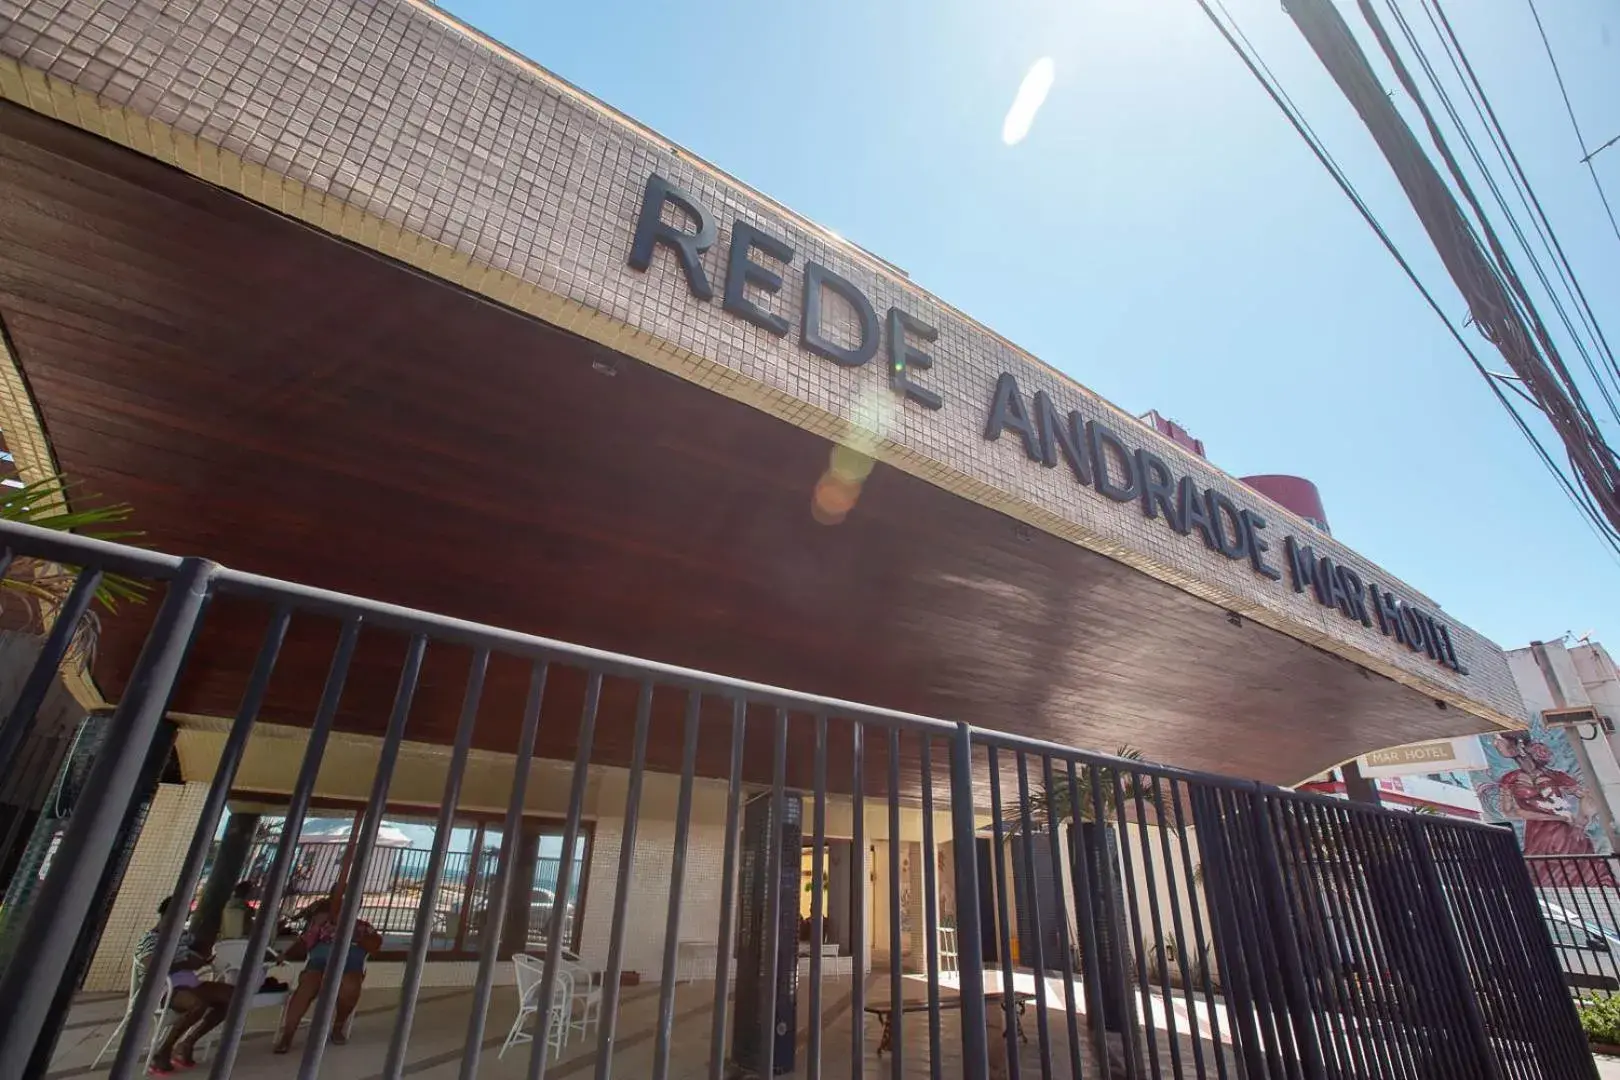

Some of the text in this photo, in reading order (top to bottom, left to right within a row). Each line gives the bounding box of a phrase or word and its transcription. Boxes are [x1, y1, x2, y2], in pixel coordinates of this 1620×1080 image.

[628, 172, 1470, 675] REDE ANDRADE MAR HOTEL
[1373, 747, 1448, 763] MAR HOTEL
